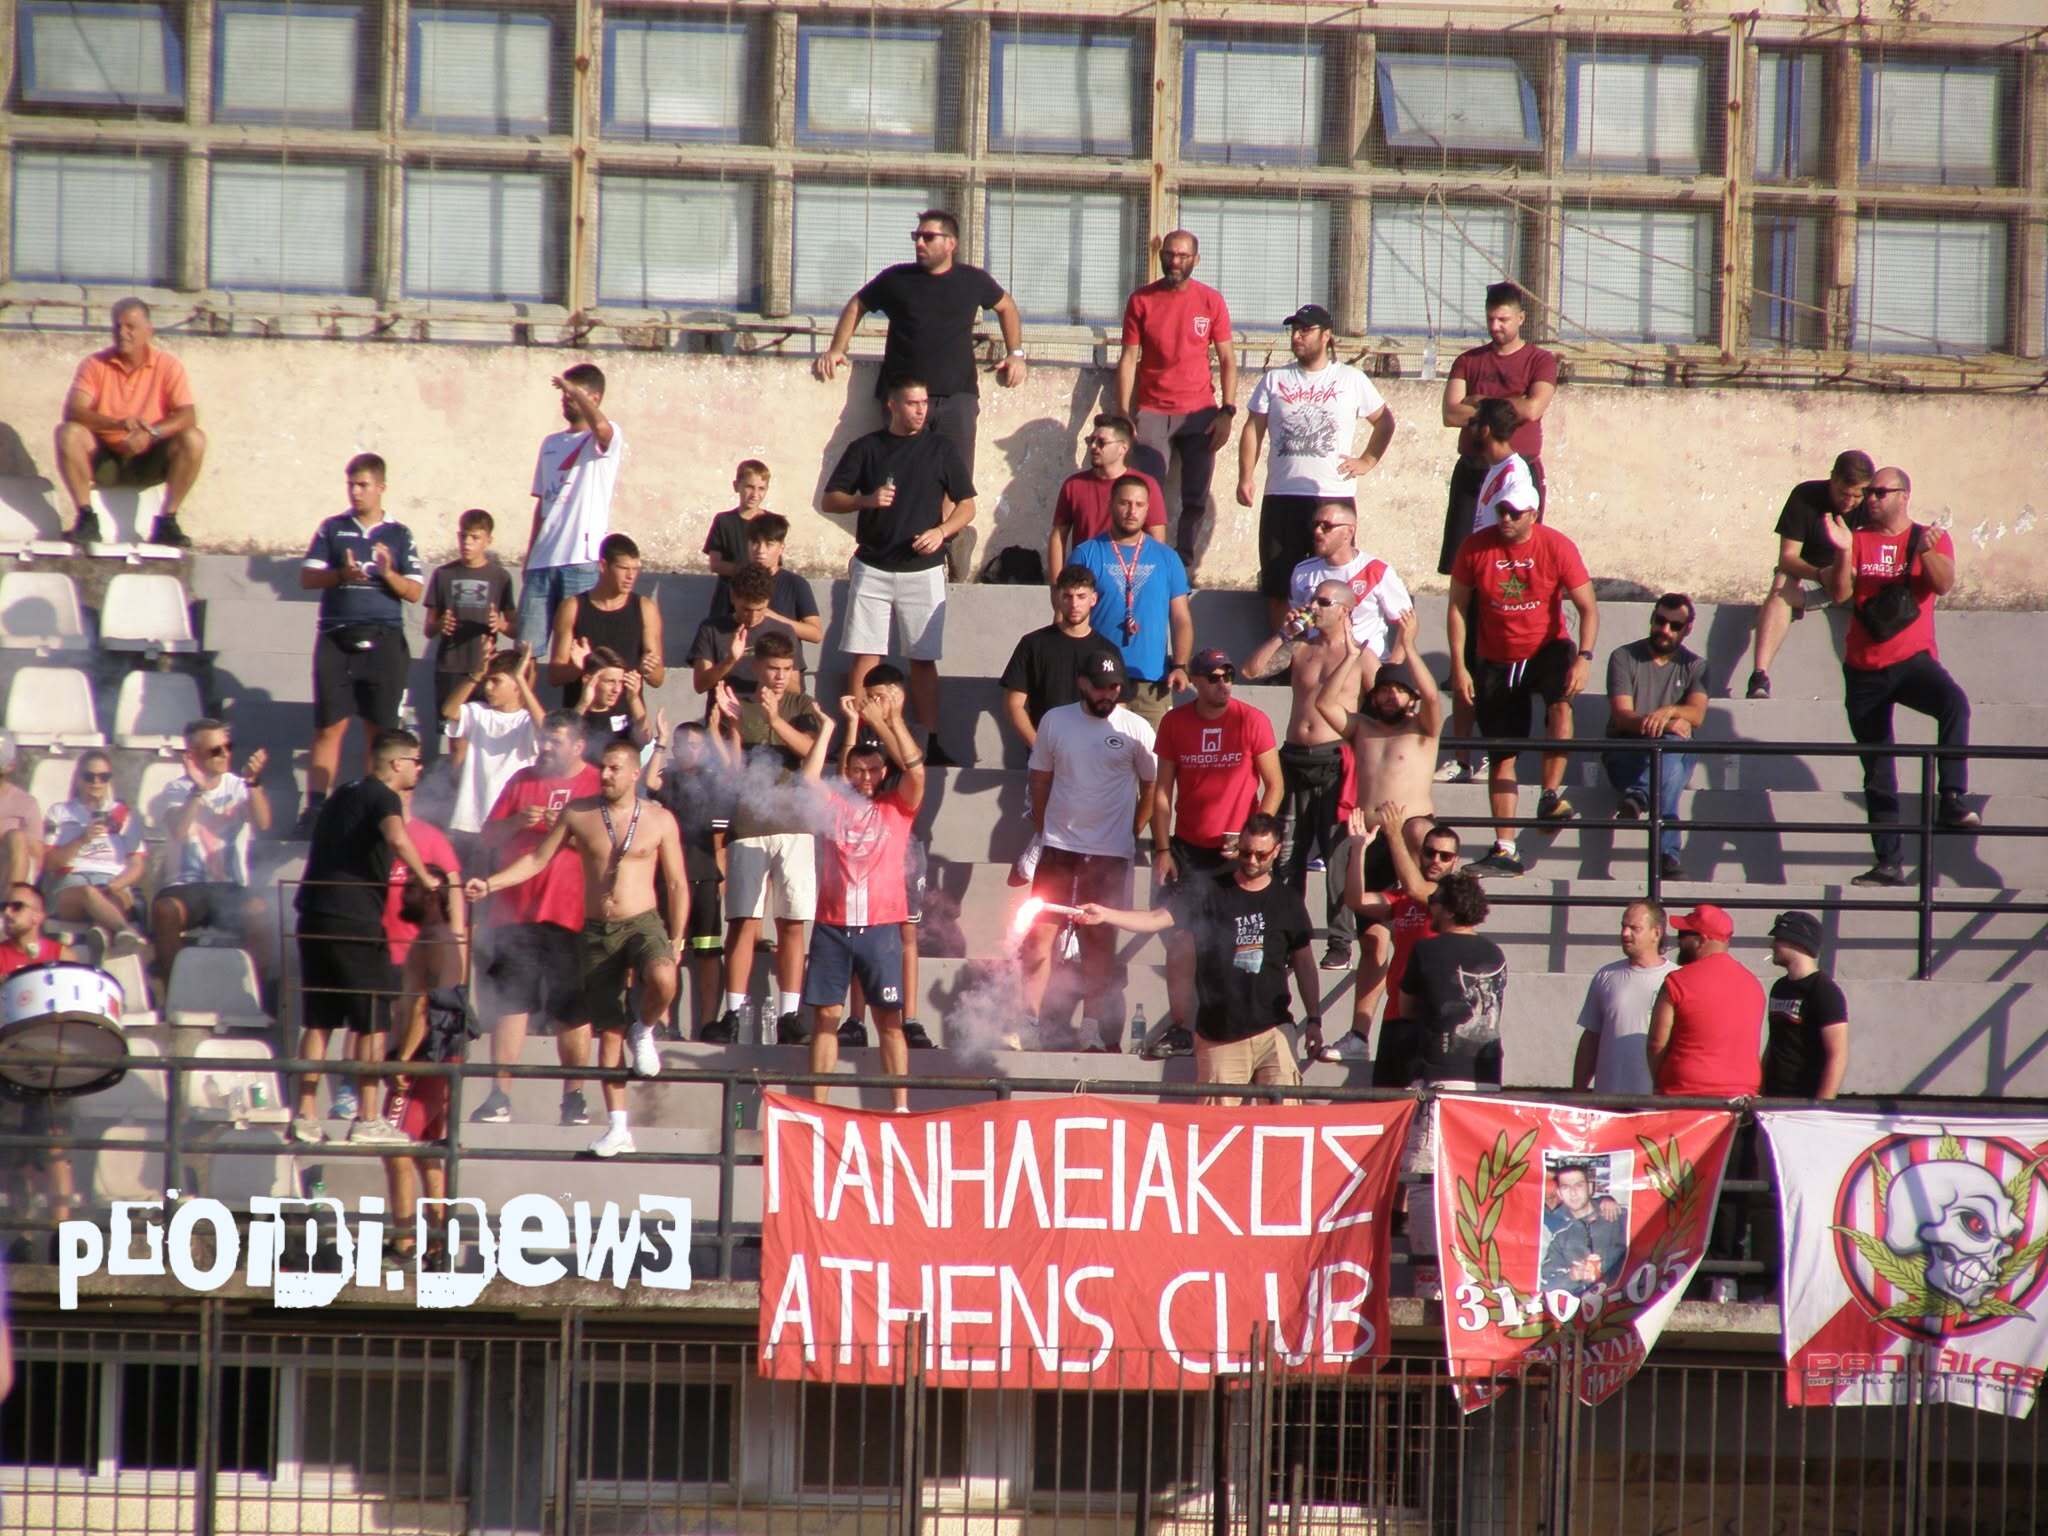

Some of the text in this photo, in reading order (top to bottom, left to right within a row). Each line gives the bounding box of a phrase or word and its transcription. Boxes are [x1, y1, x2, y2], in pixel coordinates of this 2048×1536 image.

[1180, 752, 1242, 764] PYRGOS AFC
[767, 1106, 1384, 1236] ΠΑΝΗΛΕΙΑΚΟΣ
[764, 1253, 1375, 1374] ATHENS CLUB
